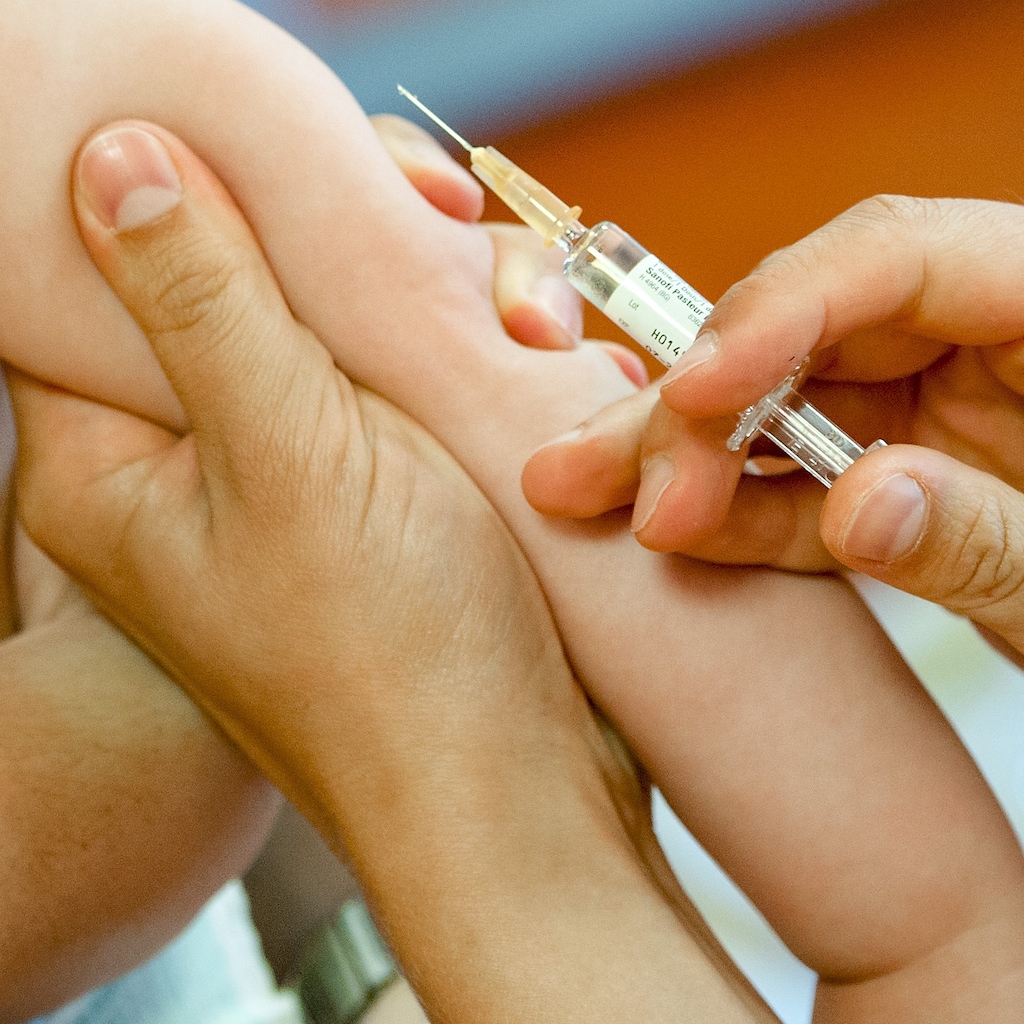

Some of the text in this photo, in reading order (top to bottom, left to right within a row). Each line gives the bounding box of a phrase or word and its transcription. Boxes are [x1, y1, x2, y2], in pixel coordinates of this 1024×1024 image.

[628, 298, 640, 311] Lot
[645, 267, 673, 291] Sanofi
[672, 288, 704, 316] Pasteur
[650, 328, 686, 357] H014
